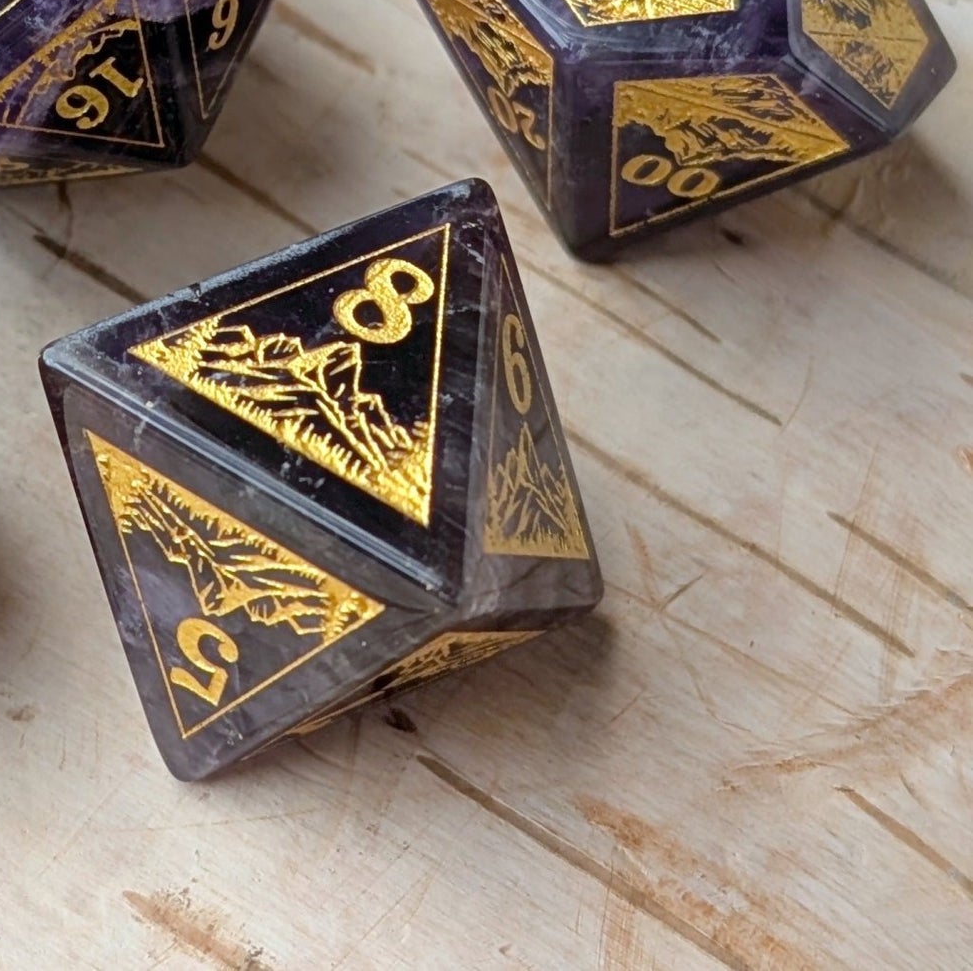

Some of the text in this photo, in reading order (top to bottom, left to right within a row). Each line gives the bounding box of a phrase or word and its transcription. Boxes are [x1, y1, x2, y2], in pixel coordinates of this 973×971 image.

[55, 56, 144, 130] 16
[487, 87, 546, 150] 20
[622, 154, 722, 200] 00
[333, 257, 436, 344] 8
[502, 314, 532, 415] 6
[169, 617, 240, 707] 5
